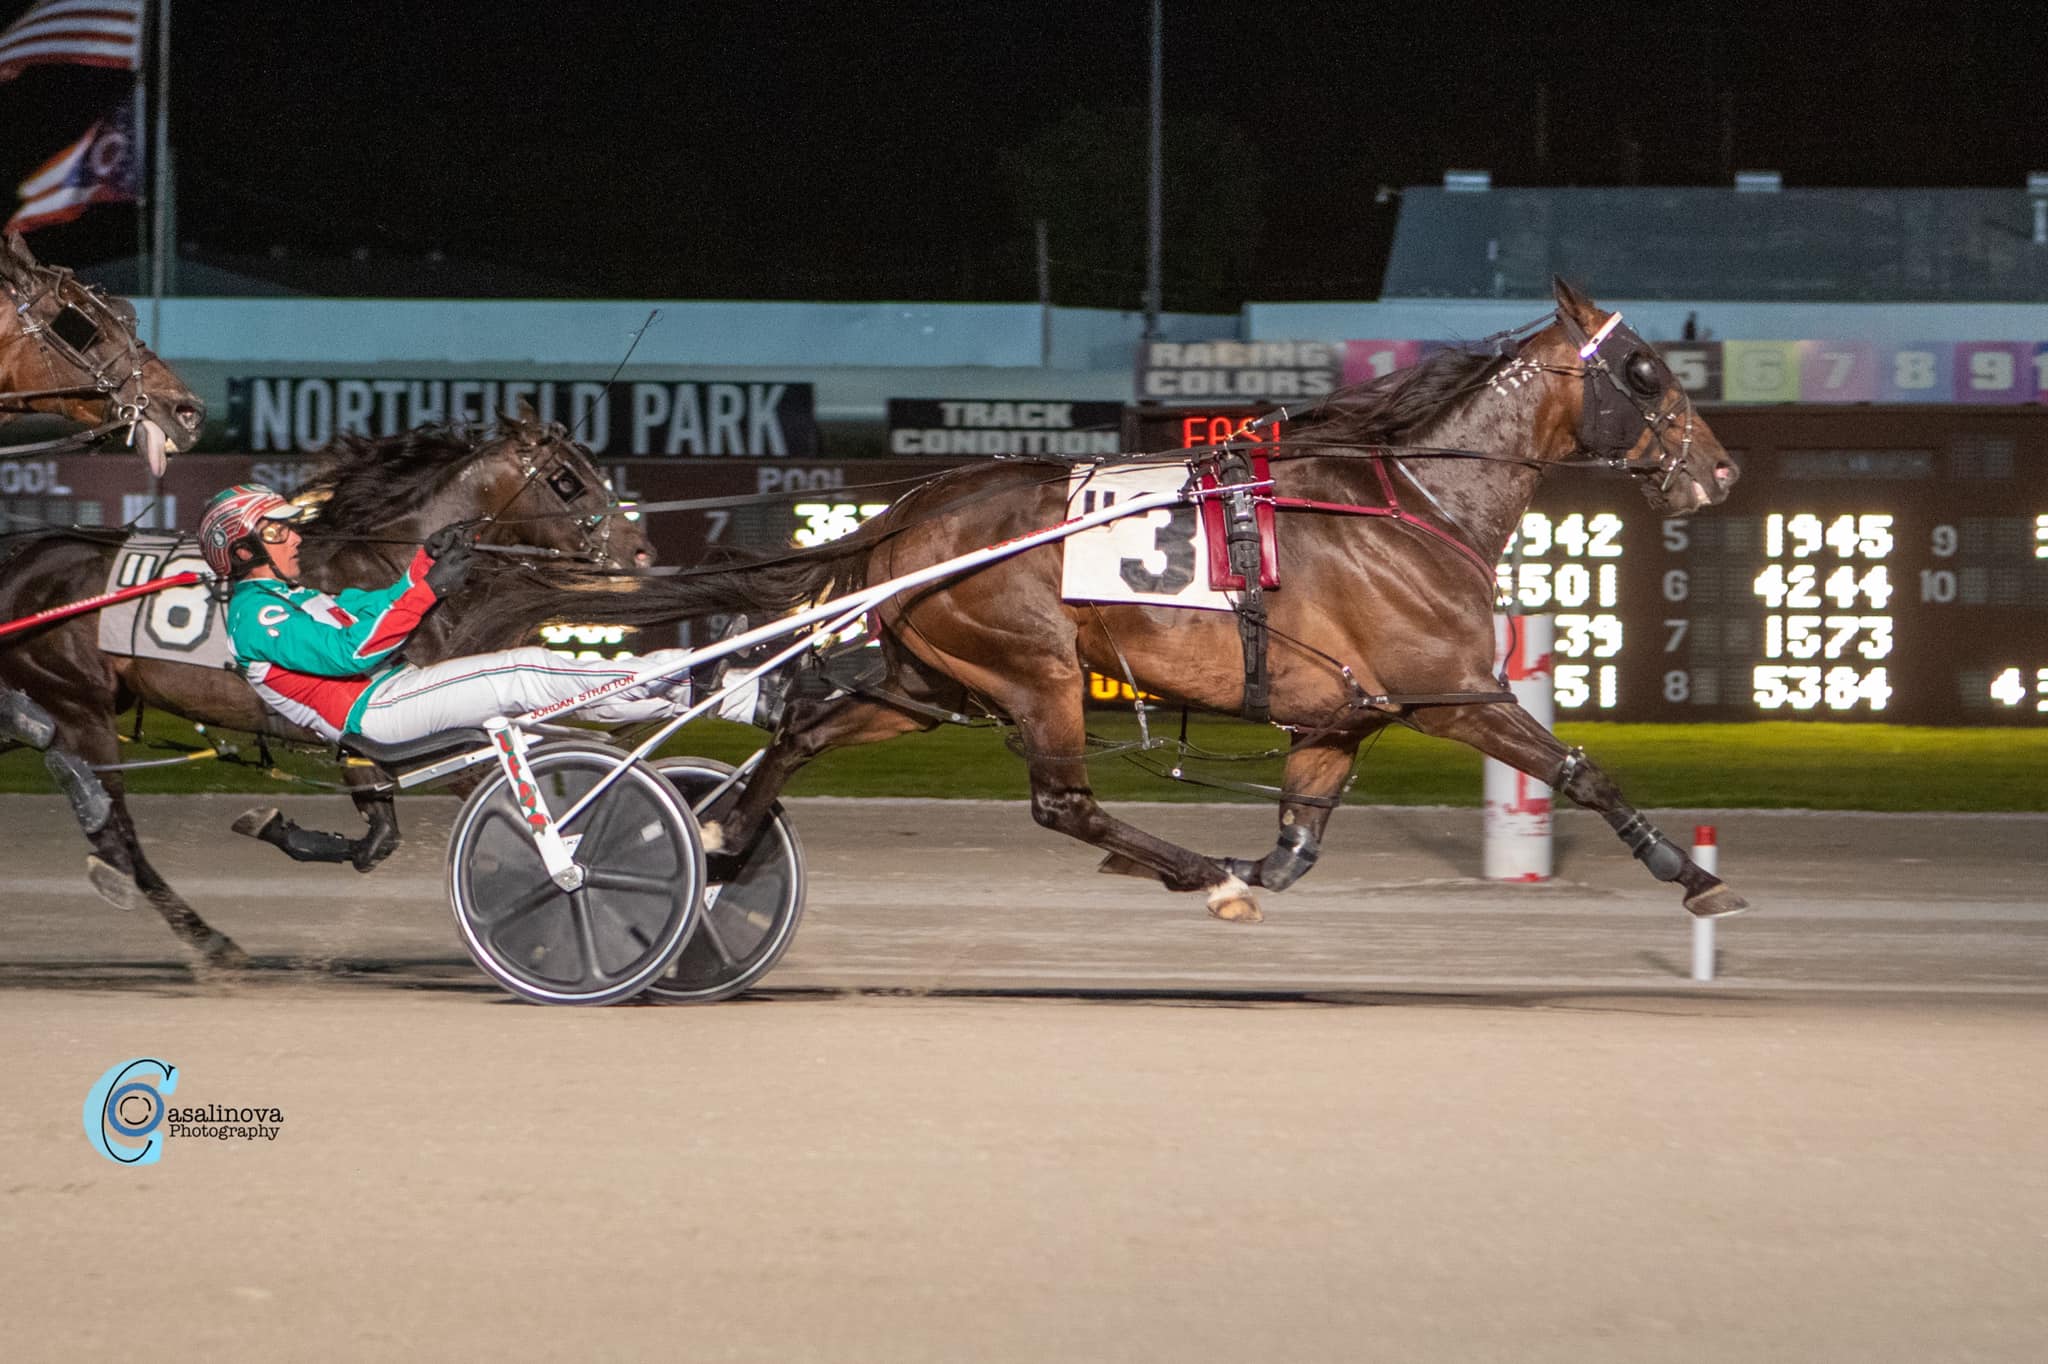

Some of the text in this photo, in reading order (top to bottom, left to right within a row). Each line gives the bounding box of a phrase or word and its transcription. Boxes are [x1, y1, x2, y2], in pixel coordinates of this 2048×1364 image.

[1150, 342, 1331, 367] RACING
[1666, 351, 1706, 389] 5
[1822, 351, 1855, 389] 7
[1895, 350, 1936, 389] 8
[1970, 351, 2014, 390] 9
[1144, 370, 1334, 395] COLORS
[631, 382, 789, 456] PARK
[939, 402, 1072, 428] TRACK
[891, 428, 1121, 455] CONDITION
[0, 461, 74, 495] OOL
[757, 467, 849, 500] POOL
[1119, 491, 1197, 596] 3
[1504, 513, 1622, 557] 942
[1663, 519, 1689, 552] 5
[1767, 514, 1893, 558] 1945
[1932, 524, 1958, 556] 9
[1663, 570, 1689, 602] 6
[1754, 565, 1893, 609] 4244
[1920, 570, 1958, 602] 10
[1555, 614, 1622, 657] 39
[1664, 620, 1689, 652] 7
[1767, 615, 1893, 659] 1573
[530, 674, 636, 720] JORDAN STRATTON
[1555, 665, 1616, 707] 51
[1664, 670, 1689, 702] 8
[1754, 666, 1893, 710] 5384
